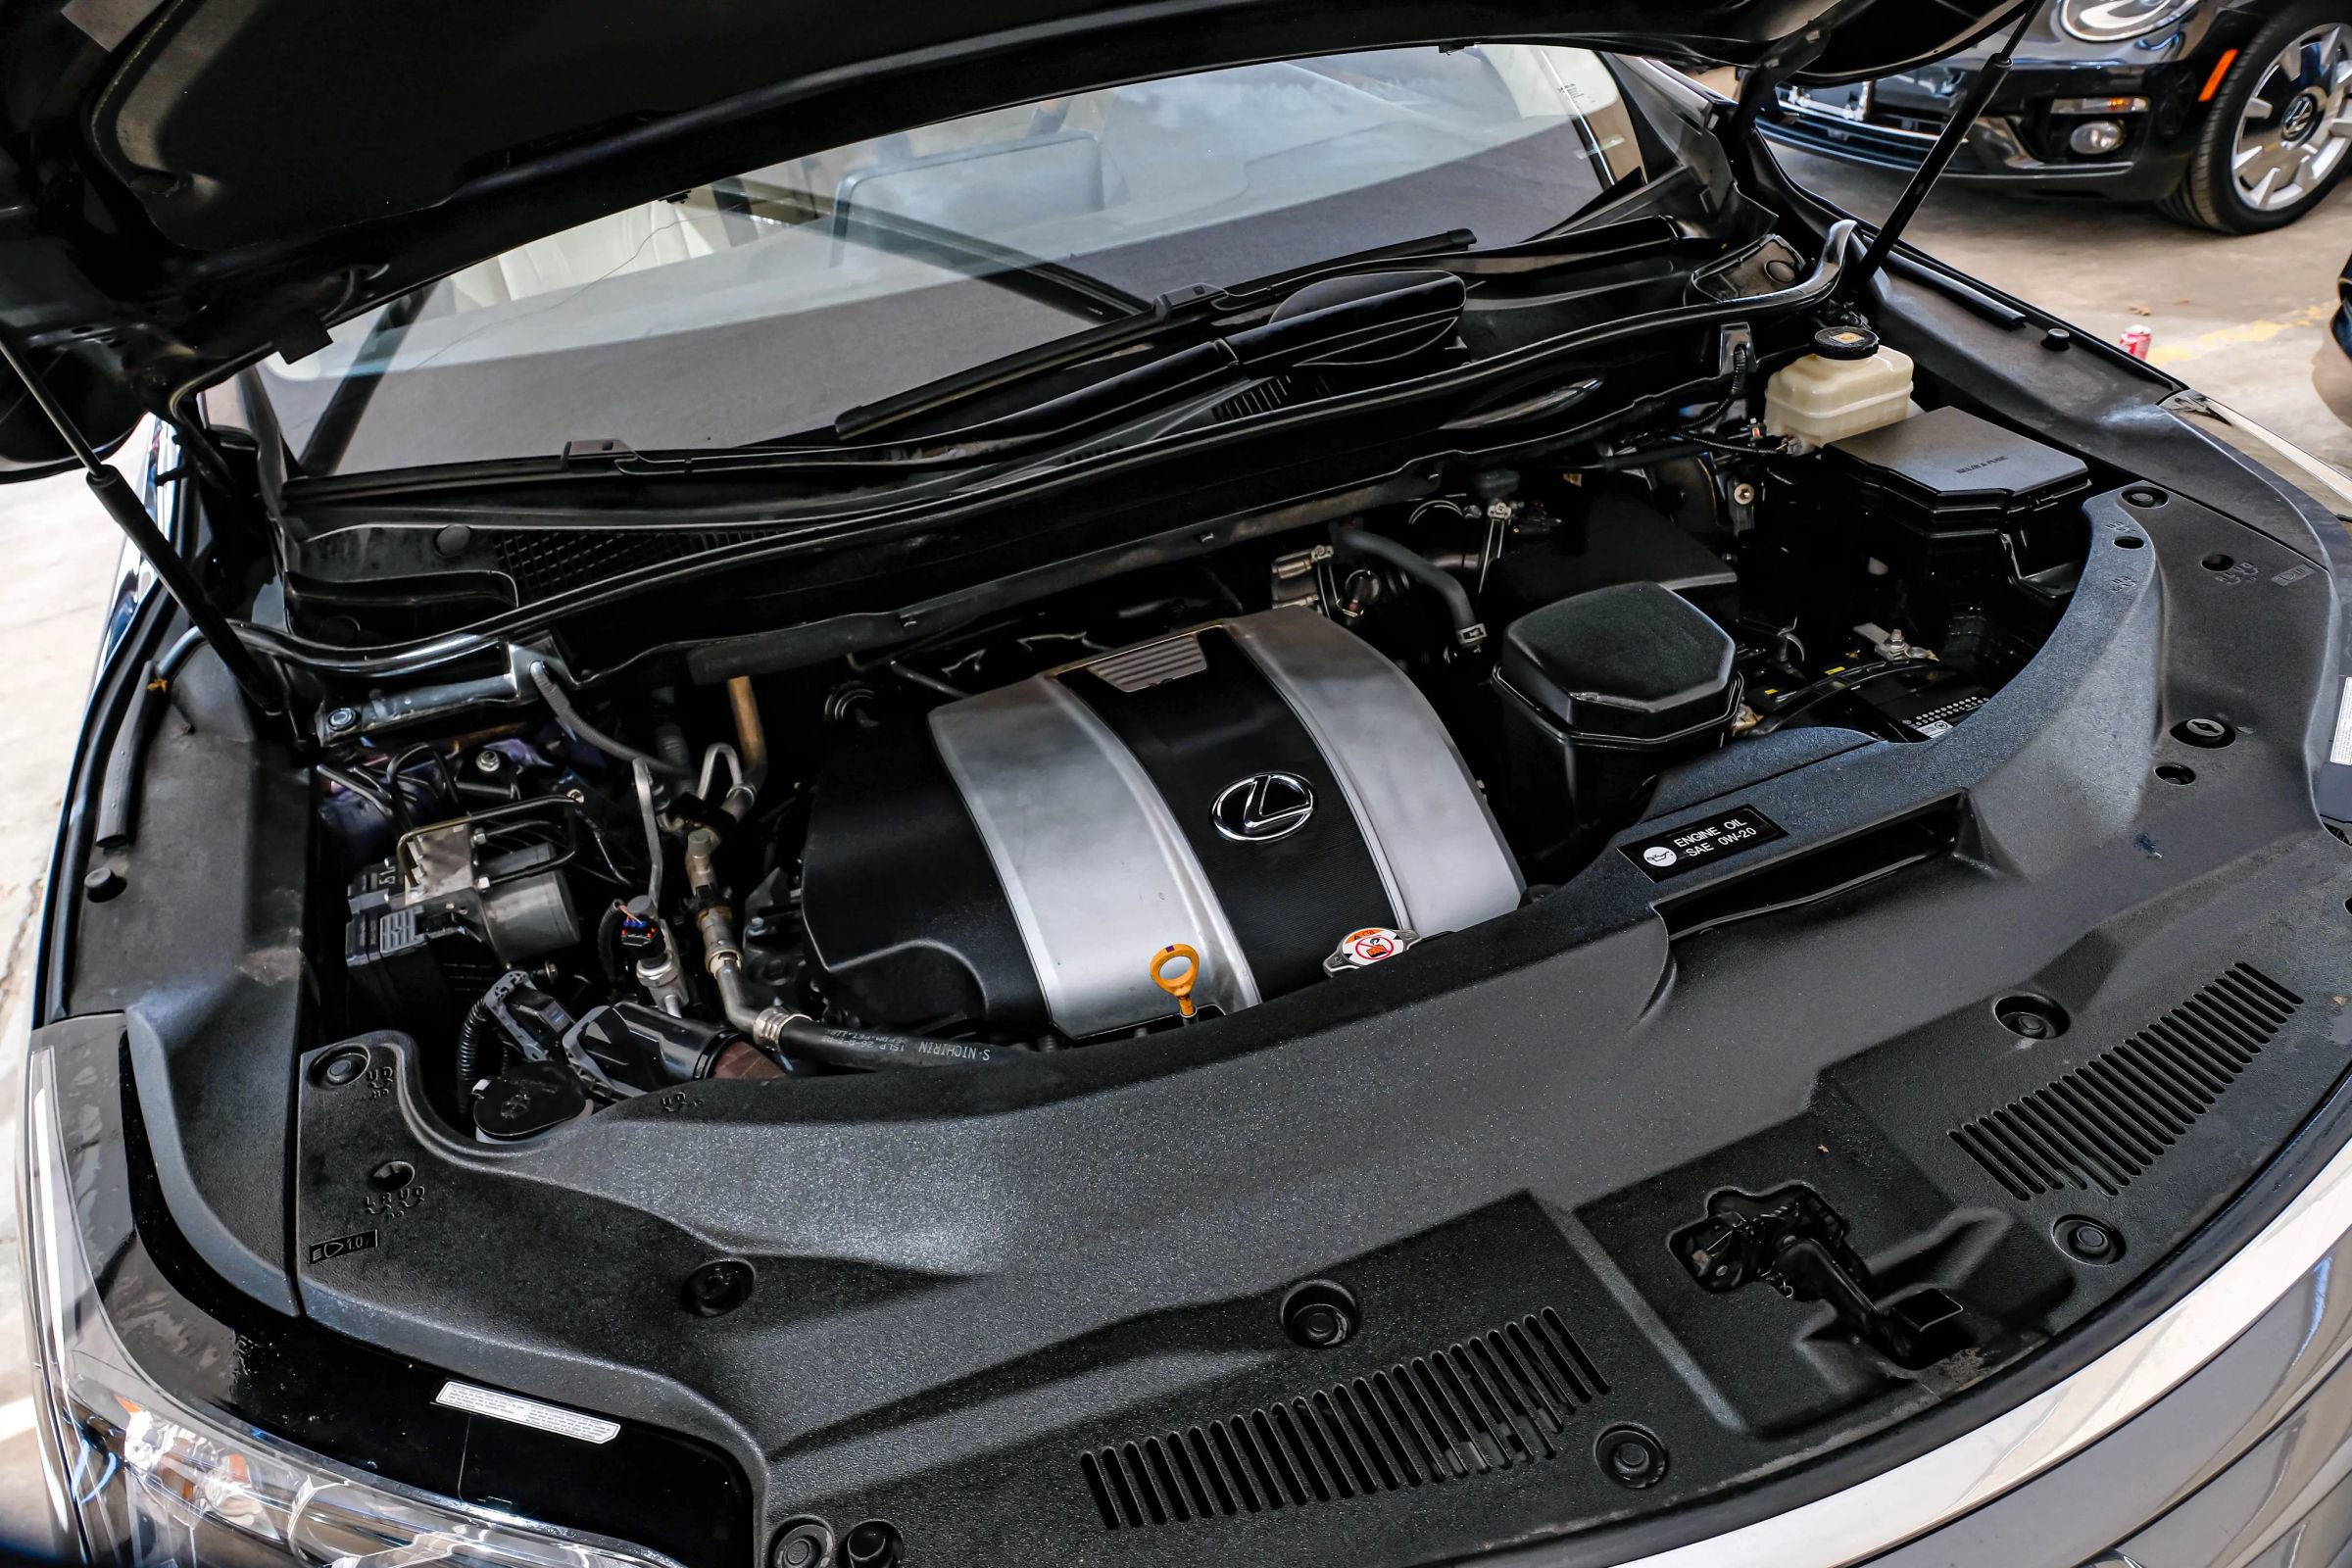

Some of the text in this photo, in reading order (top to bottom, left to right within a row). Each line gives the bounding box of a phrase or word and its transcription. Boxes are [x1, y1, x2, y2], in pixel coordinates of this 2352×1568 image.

[1673, 818, 1747, 848] ENGINE OIL
[1686, 827, 1757, 857] SAE 0W-20
